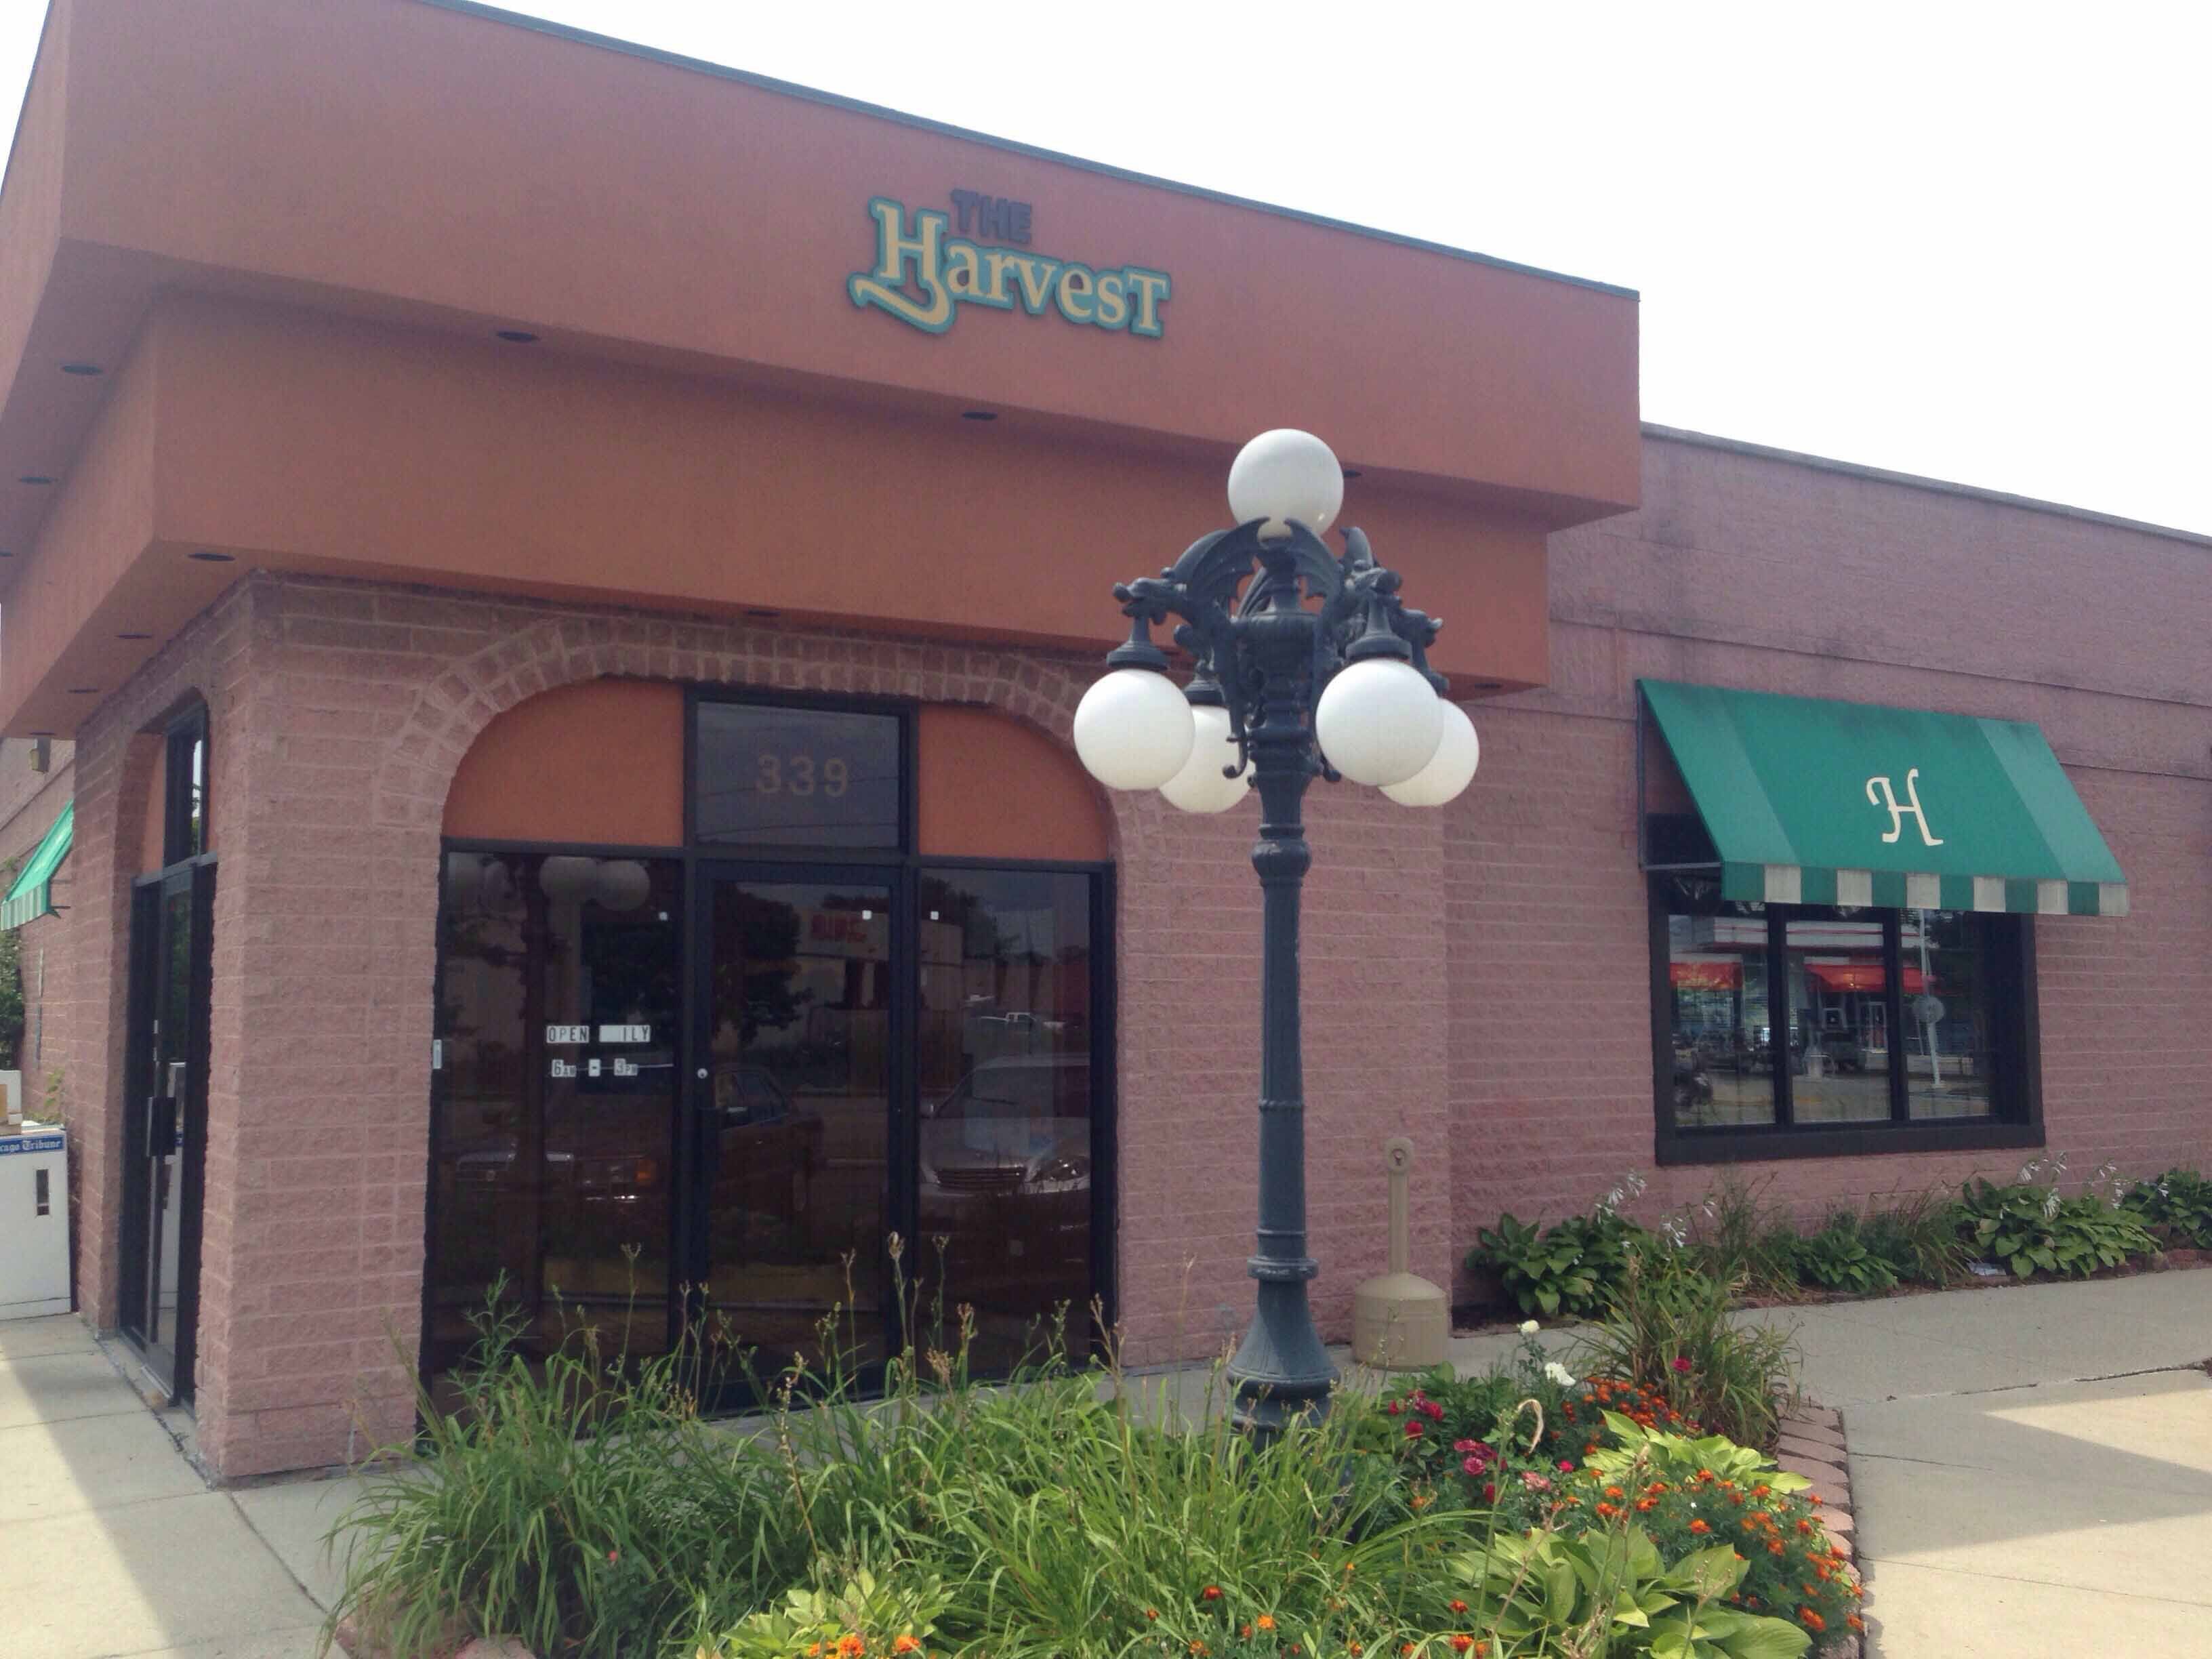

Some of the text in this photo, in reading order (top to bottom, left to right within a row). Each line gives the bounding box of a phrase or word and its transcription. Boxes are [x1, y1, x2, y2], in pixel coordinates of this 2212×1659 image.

[951, 189, 1032, 243] THE
[758, 753, 848, 798] 339
[1866, 769, 1944, 846] H
[548, 1026, 588, 1042] OPEN
